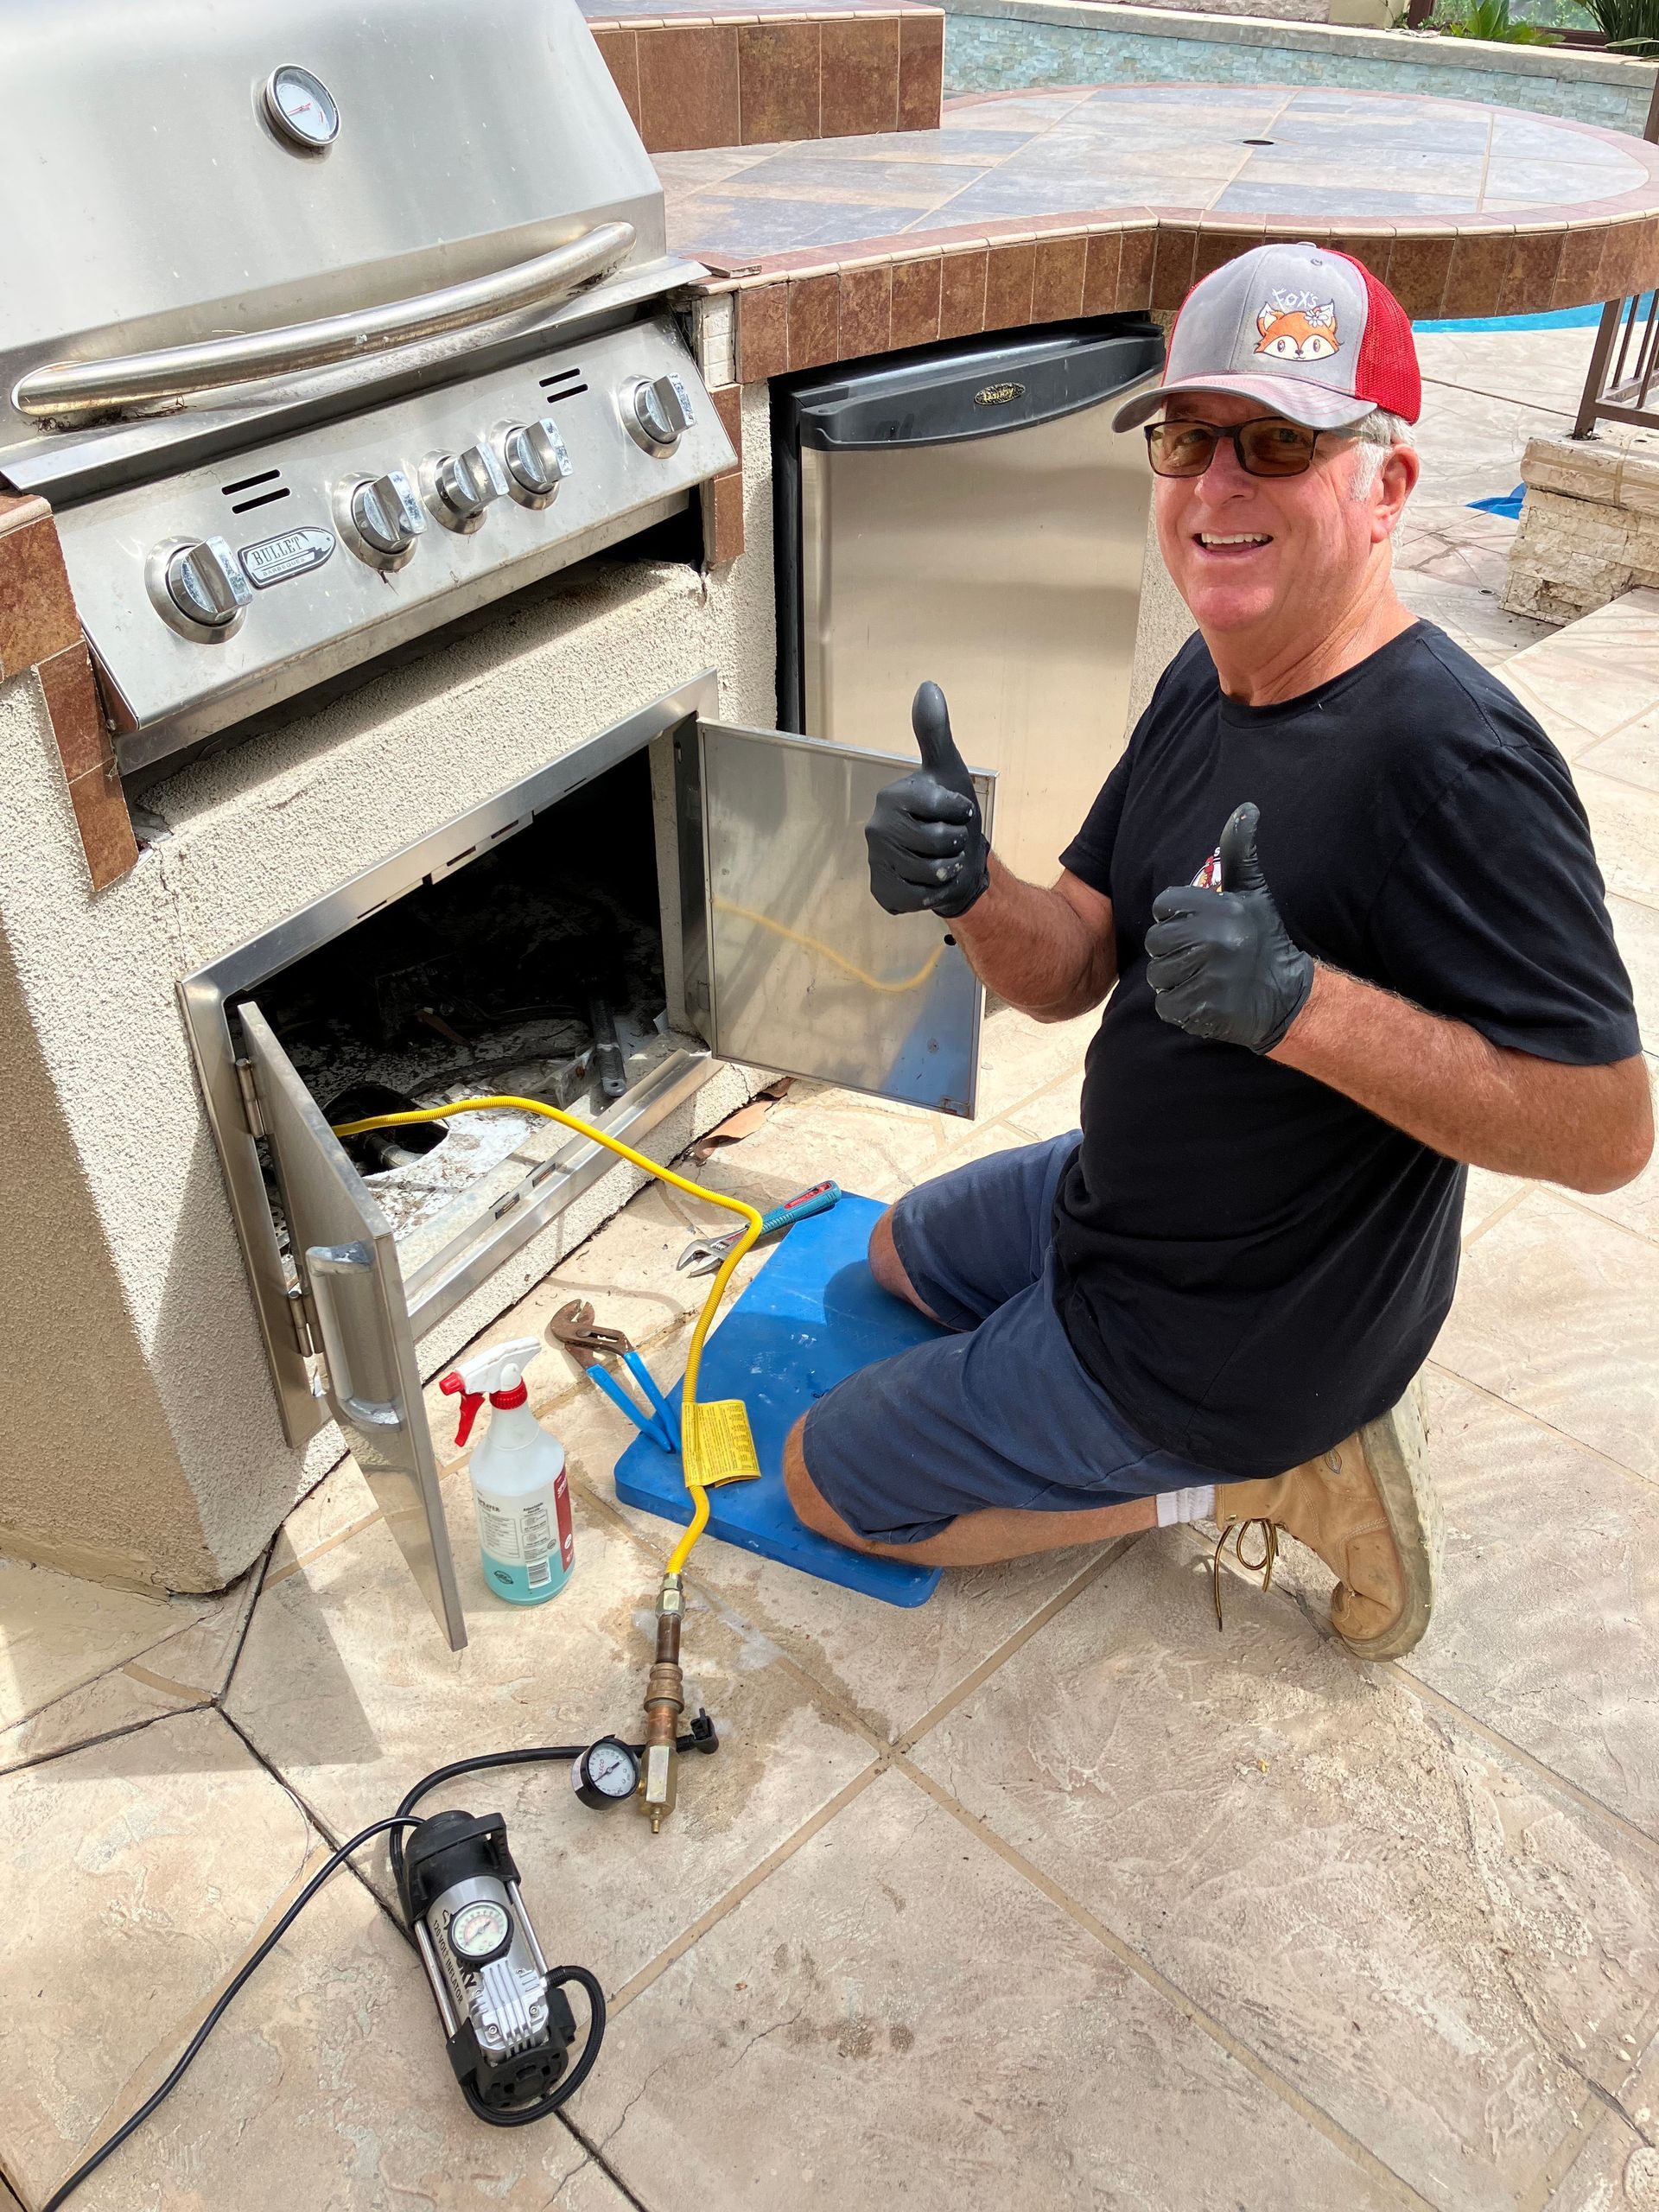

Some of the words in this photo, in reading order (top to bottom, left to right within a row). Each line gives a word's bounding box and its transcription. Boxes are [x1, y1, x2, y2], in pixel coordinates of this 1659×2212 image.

[251, 537, 302, 566] BULLET
[438, 1935, 450, 1958] VOLT
[445, 1958, 463, 2005] INFLATOR
